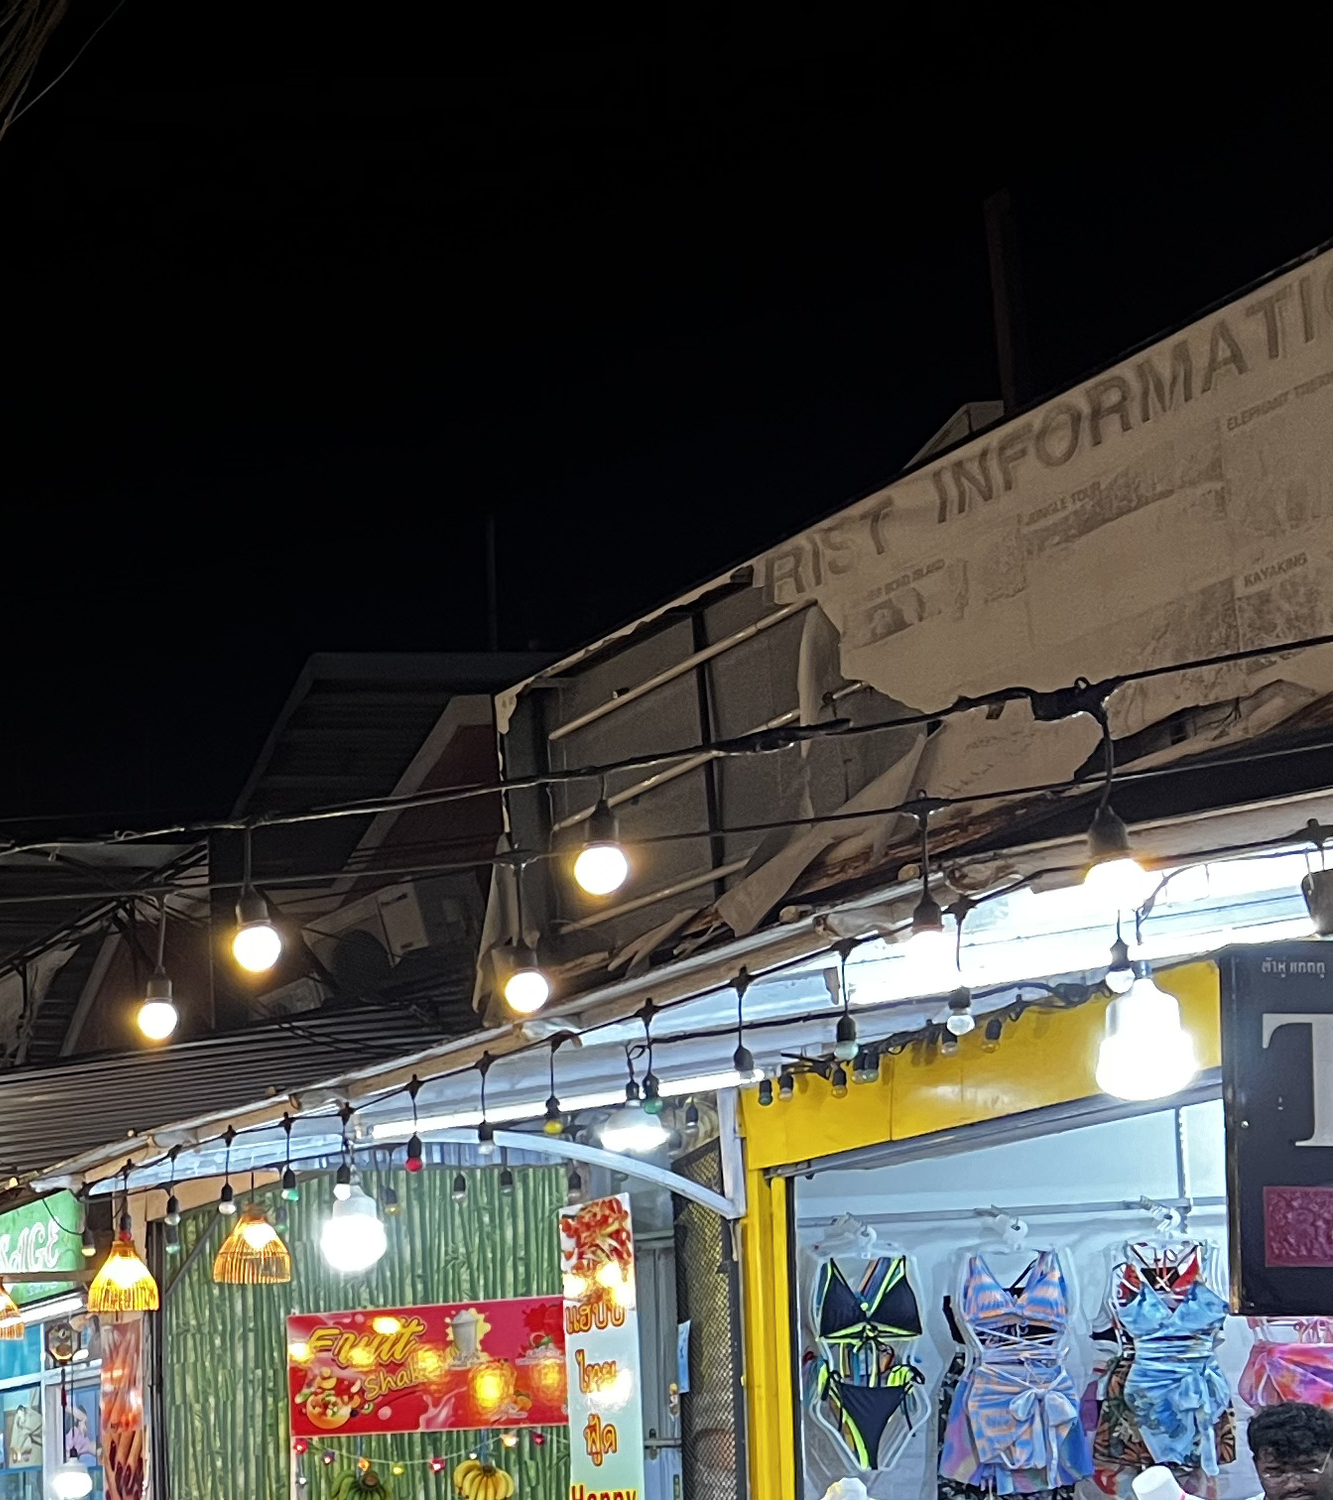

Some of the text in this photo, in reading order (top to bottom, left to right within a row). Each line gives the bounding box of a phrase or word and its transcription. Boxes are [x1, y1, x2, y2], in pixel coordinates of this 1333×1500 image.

[931, 270, 1333, 524] INFORMATI
[1244, 552, 1308, 587] KAYAKING
[363, 1361, 437, 1401] Shak
